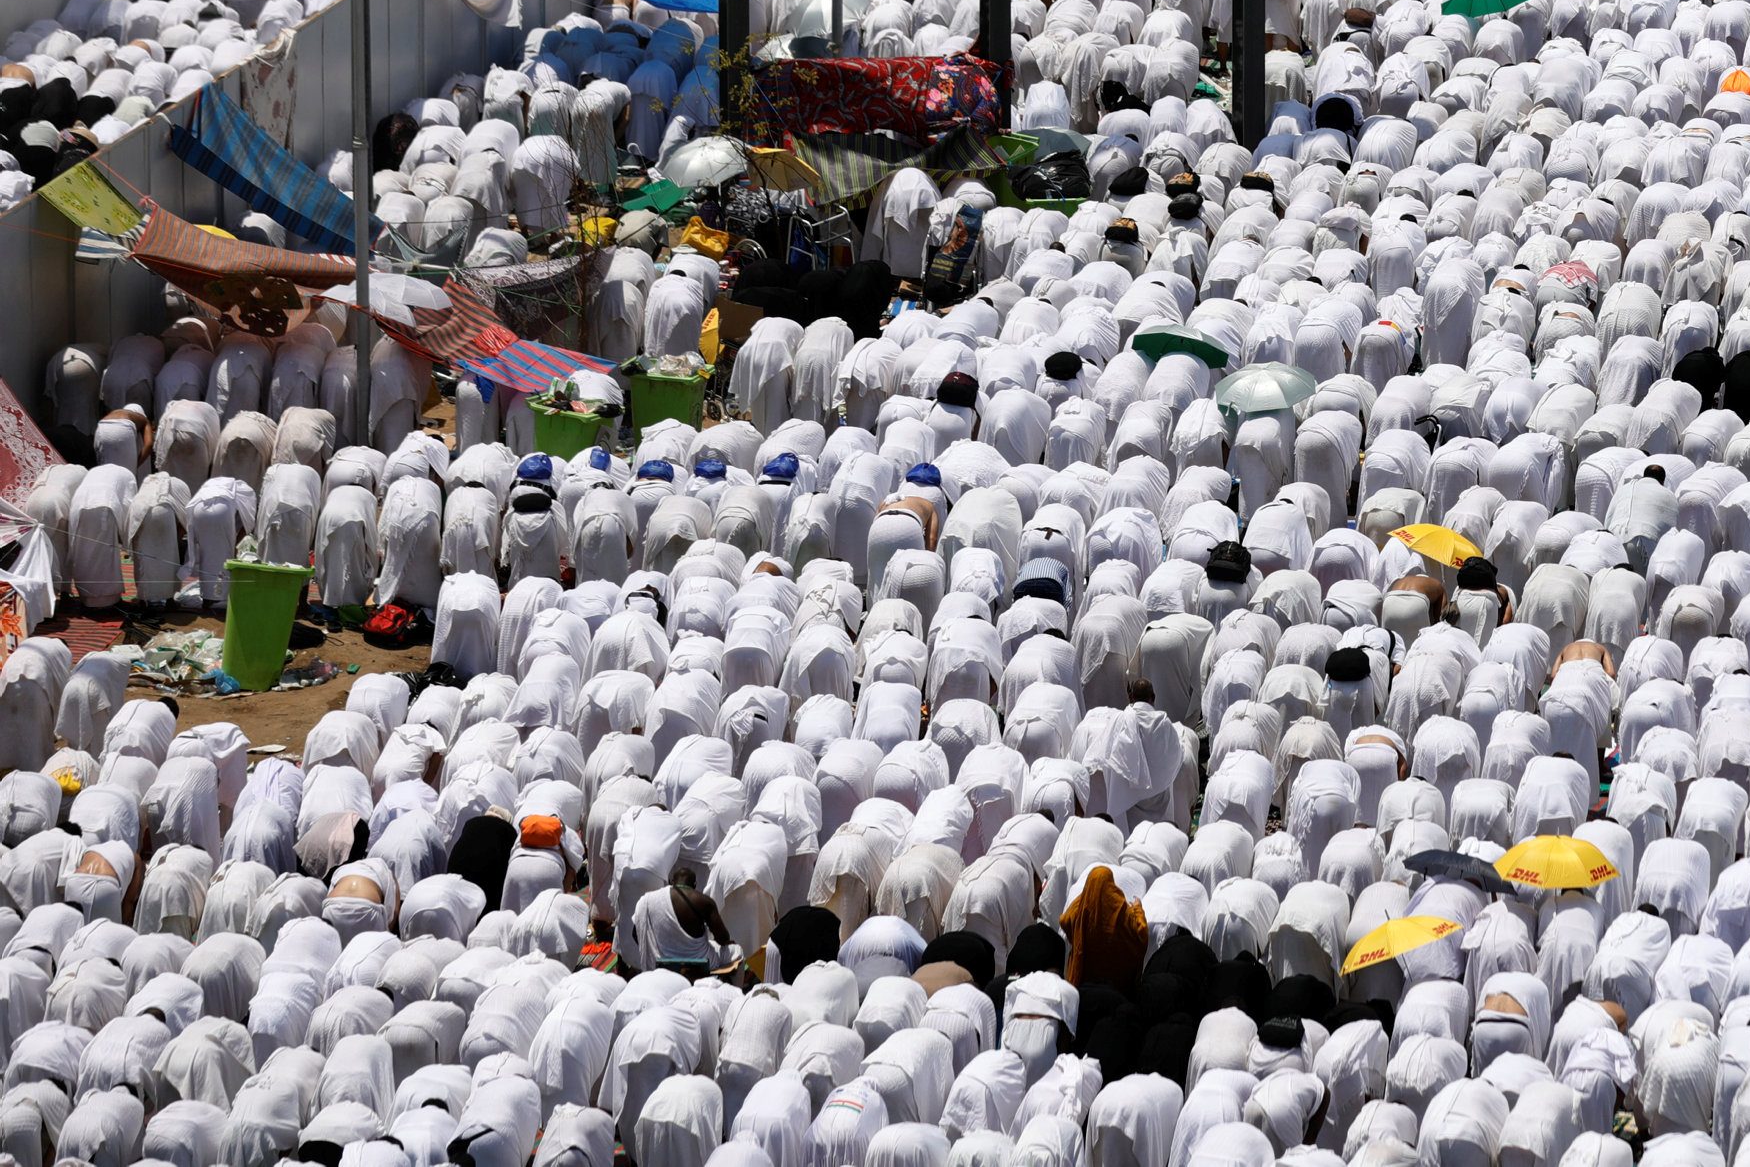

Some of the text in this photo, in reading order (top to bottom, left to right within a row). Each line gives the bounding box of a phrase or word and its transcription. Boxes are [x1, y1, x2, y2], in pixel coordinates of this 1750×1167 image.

[1395, 530, 1415, 542] DHL
[1511, 867, 1540, 883] DHL
[1590, 864, 1613, 881] DHL
[1358, 948, 1386, 964] DHL
